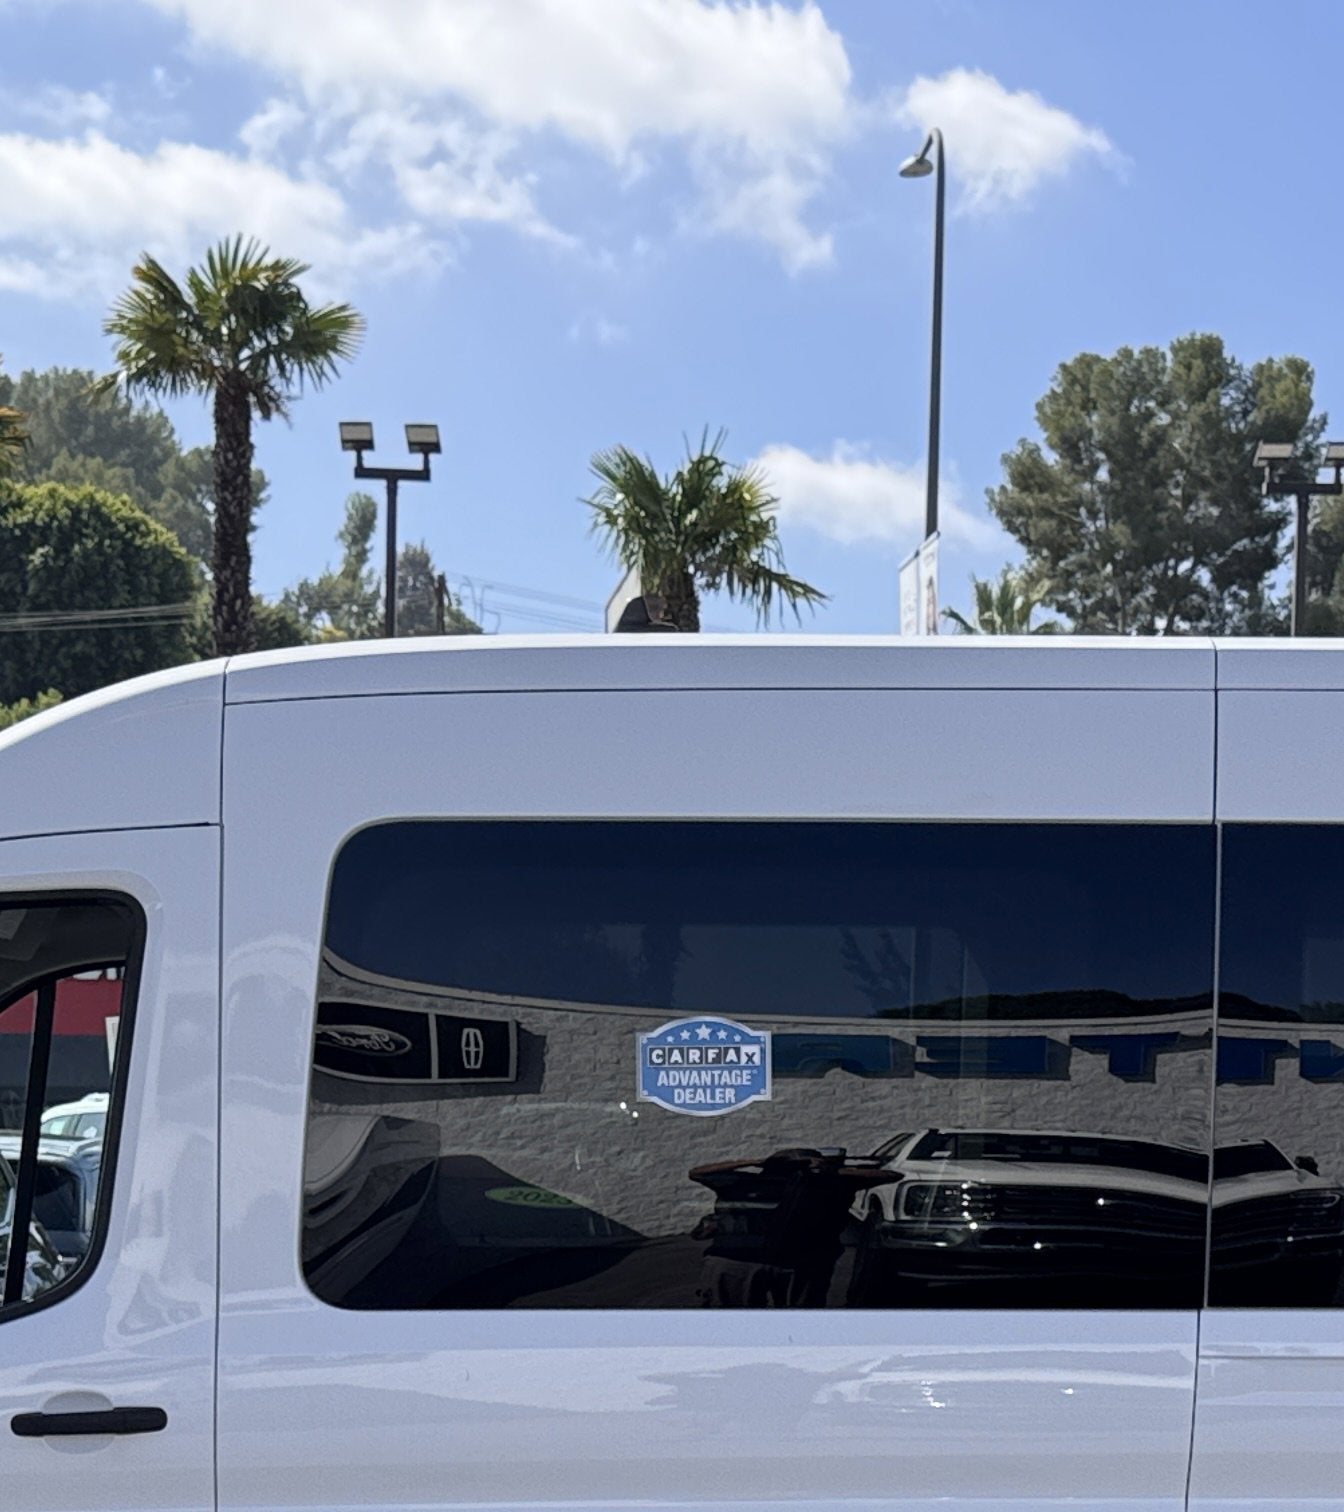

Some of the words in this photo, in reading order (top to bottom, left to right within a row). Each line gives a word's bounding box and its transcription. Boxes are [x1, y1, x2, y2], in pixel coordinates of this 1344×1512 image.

[651, 1047, 757, 1066] CARFAX
[657, 1068, 752, 1087] ADVANTAGE
[674, 1087, 736, 1104] DEALER
